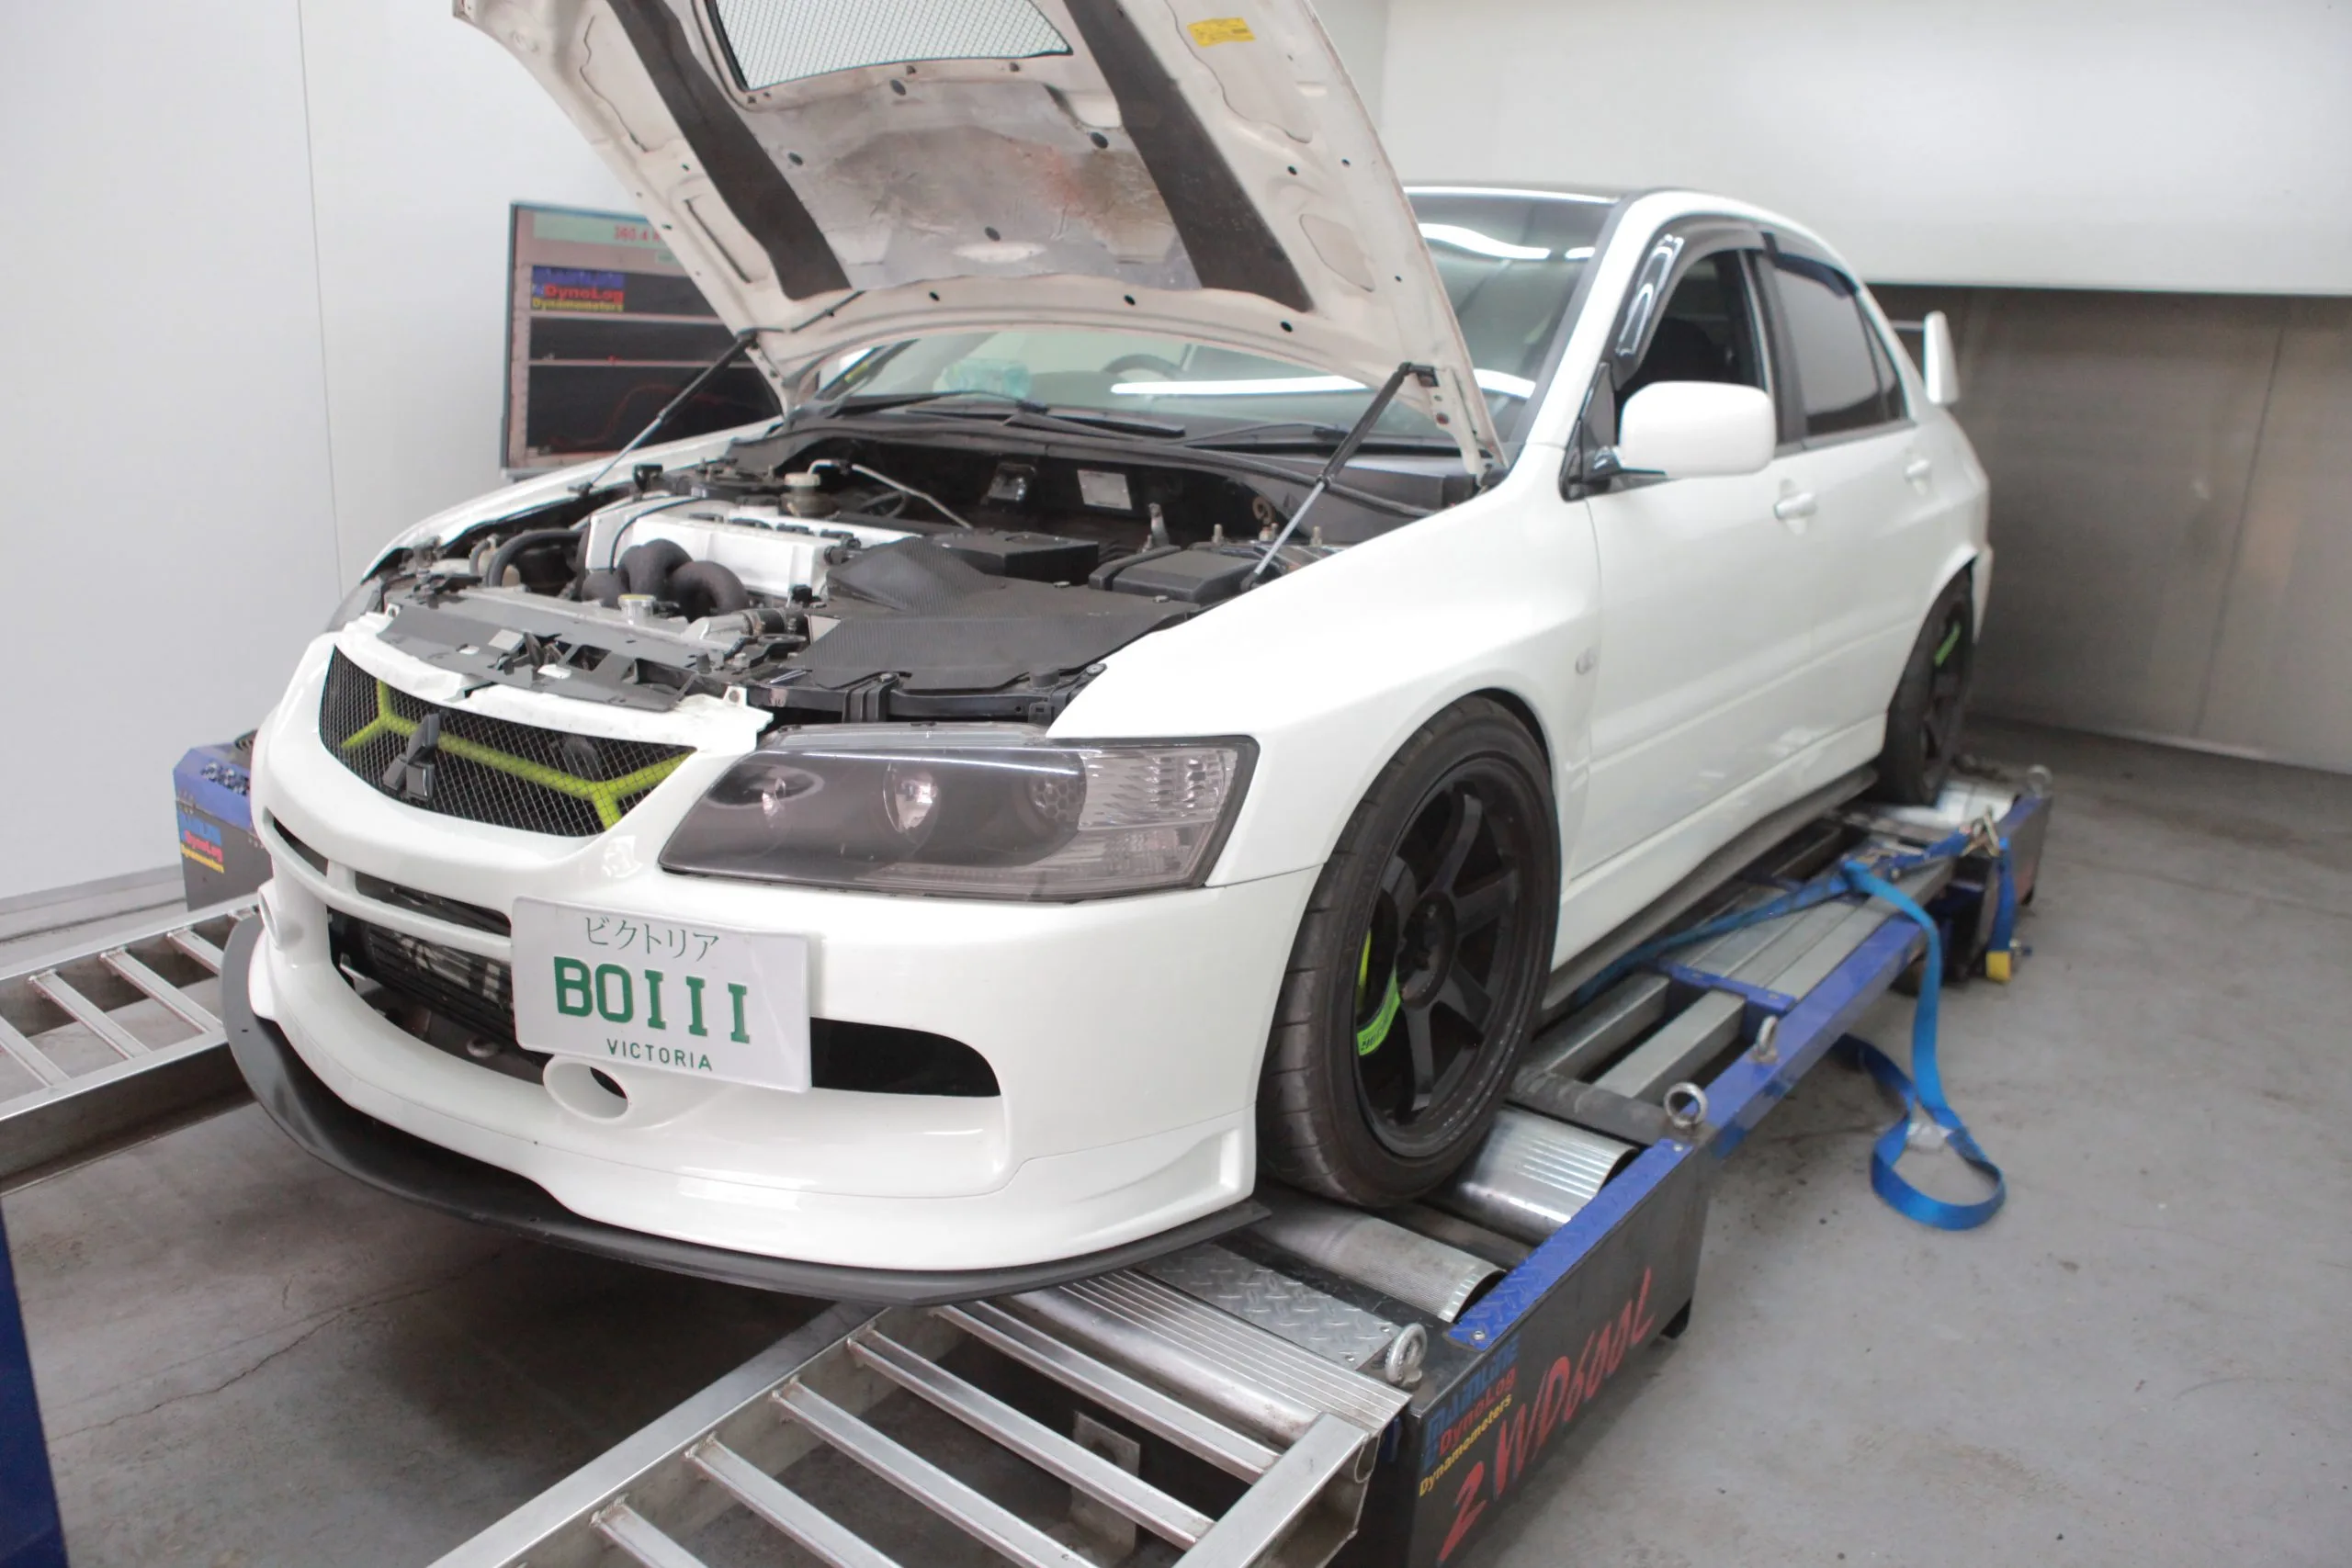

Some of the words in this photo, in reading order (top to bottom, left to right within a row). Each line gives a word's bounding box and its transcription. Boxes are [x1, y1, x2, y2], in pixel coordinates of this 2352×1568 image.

[544, 283, 624, 305] DynoLog
[585, 916, 719, 962] ビクトリア
[606, 1038, 713, 1071] VICTORIA
[1439, 1366, 1517, 1457] DynoLog
[1419, 1393, 1512, 1498] Dynamometers
